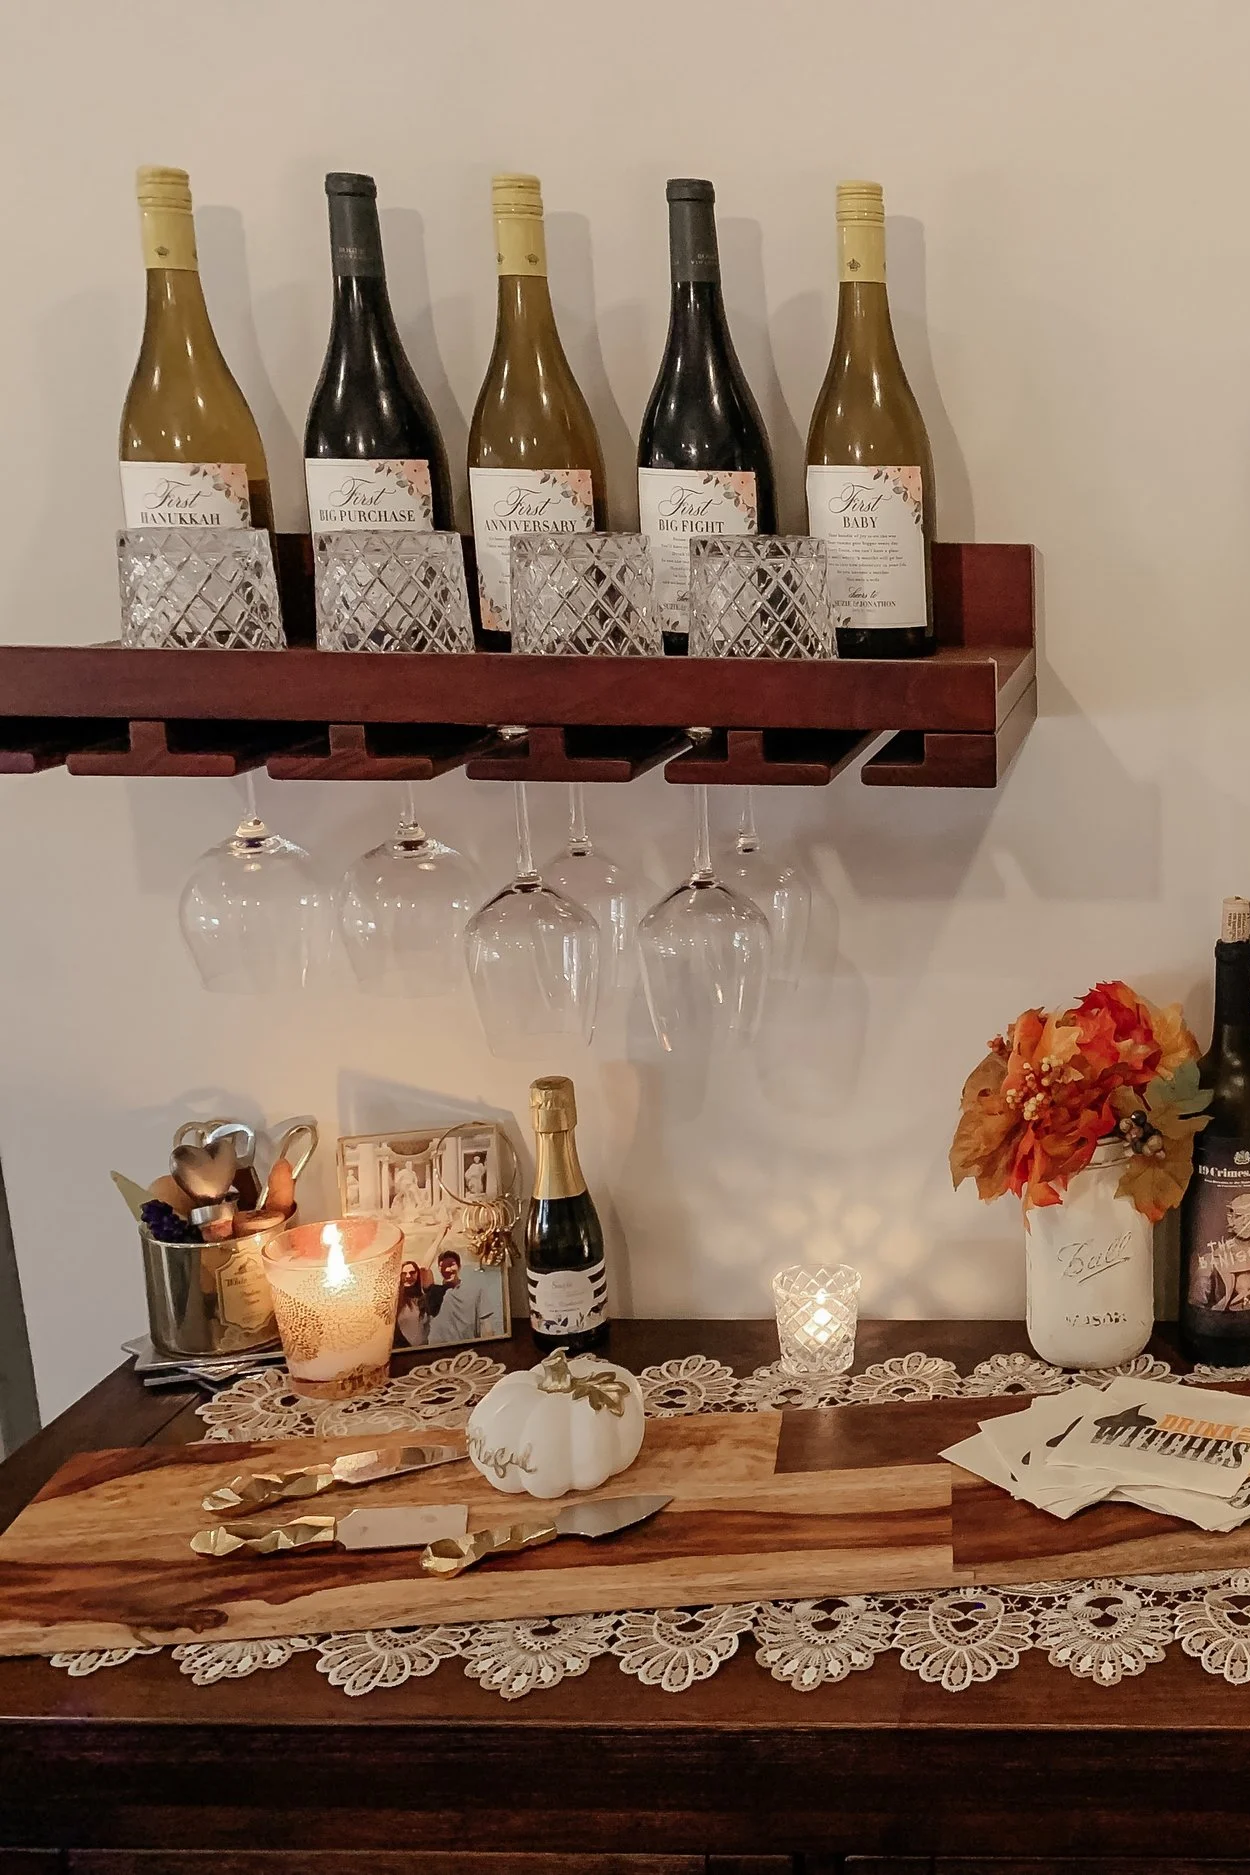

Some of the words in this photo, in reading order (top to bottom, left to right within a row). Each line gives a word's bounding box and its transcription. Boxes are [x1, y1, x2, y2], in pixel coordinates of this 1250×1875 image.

[145, 478, 213, 509] First
[328, 476, 397, 508] First
[494, 486, 562, 517] First
[659, 486, 723, 517] First
[828, 482, 893, 514] First
[140, 509, 221, 526] HANUKKAH
[319, 509, 337, 522] BIG
[339, 509, 416, 523] PURCHASE
[485, 519, 577, 532] ANNIVERSARY
[659, 519, 679, 532] BIG
[682, 520, 725, 534] FIGHT
[843, 516, 878, 528] BABY
[1198, 1164, 1209, 1175] 19
[1057, 1231, 1132, 1278] Ball
[1157, 1414, 1239, 1440] DRINK
